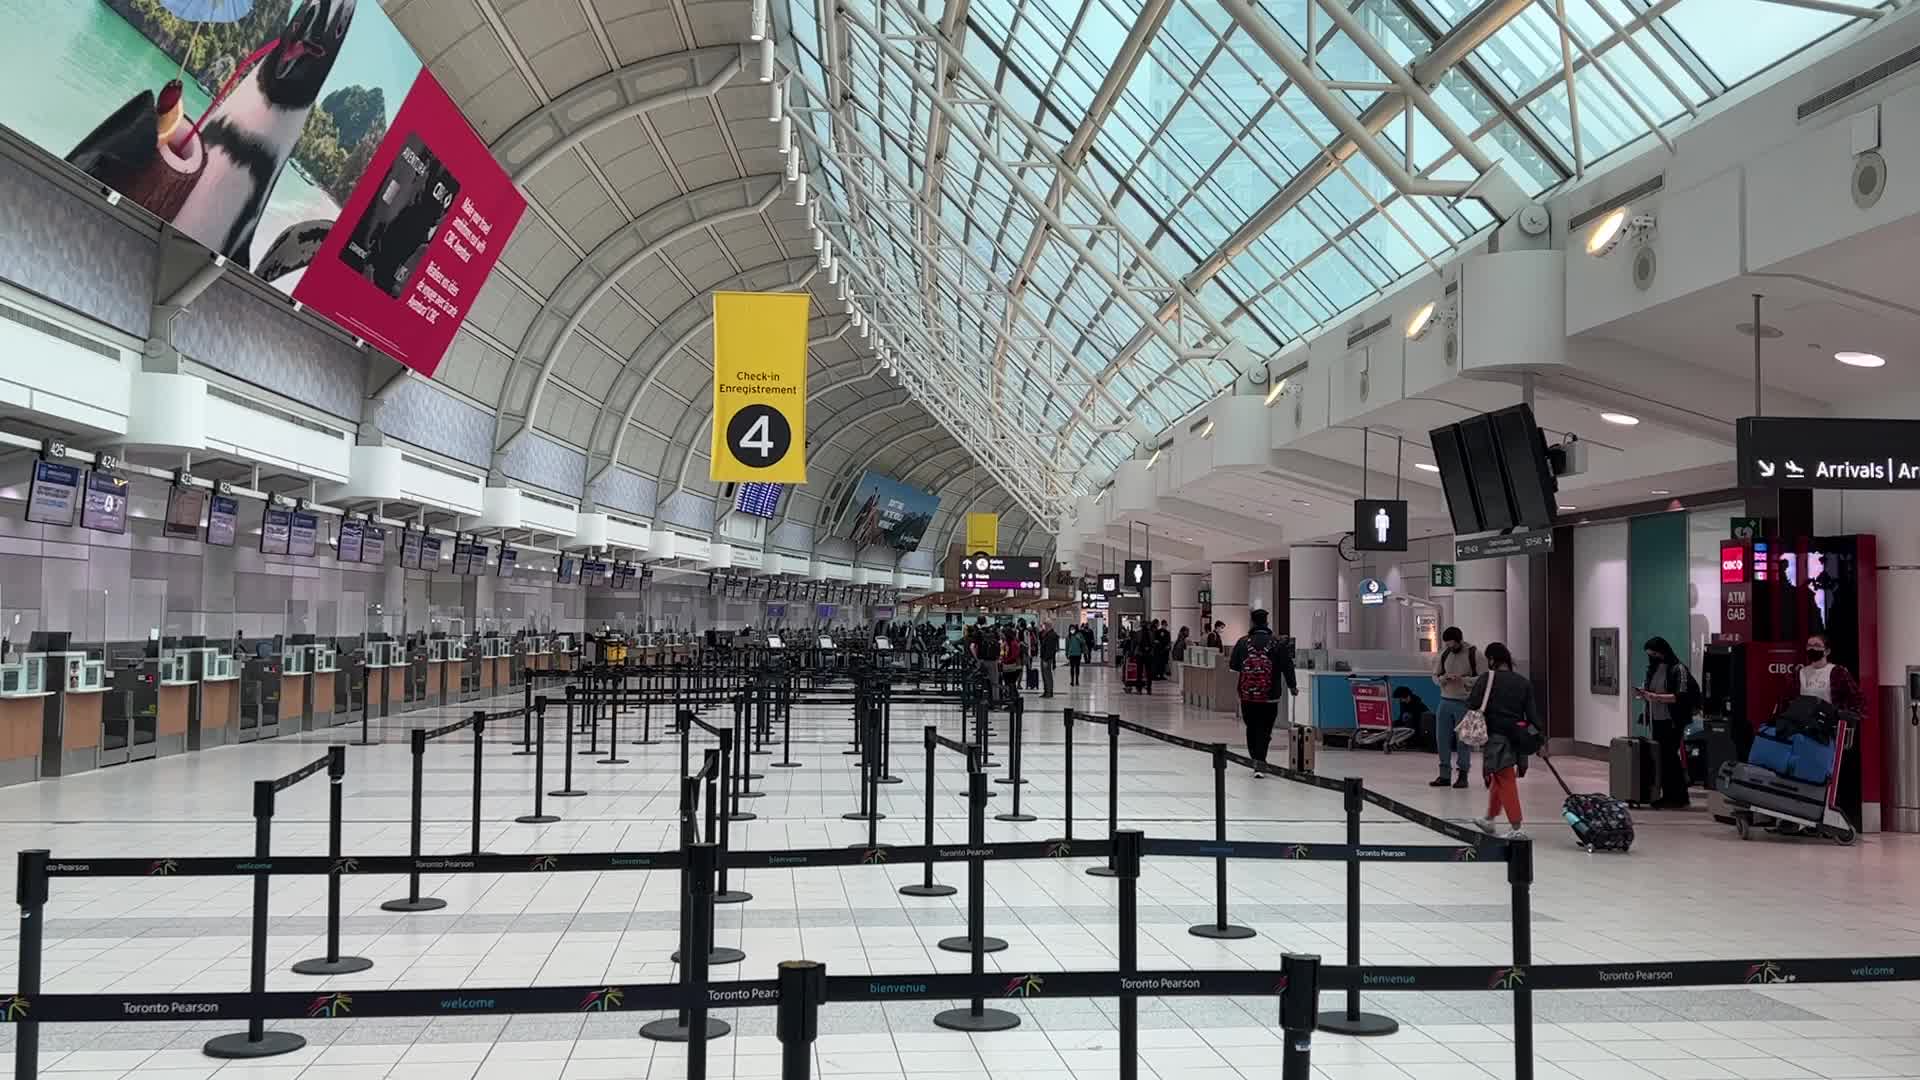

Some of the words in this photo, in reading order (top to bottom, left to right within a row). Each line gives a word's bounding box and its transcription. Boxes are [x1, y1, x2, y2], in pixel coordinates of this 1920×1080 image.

[737, 371, 780, 381] Check-in
[719, 384, 797, 395] Enregistrement
[739, 415, 774, 457] 4
[50, 442, 65, 458] 425
[101, 455, 116, 469] 424
[1816, 461, 1884, 479] Arrivals
[1722, 560, 1737, 570] CIBC
[1727, 591, 1746, 604] ATM
[1727, 607, 1746, 620] GAB
[1768, 663, 1794, 674] CIBC
[940, 848, 966, 857] Toronto
[966, 848, 994, 856] Pearson
[1355, 849, 1380, 857] Toronto
[1381, 849, 1407, 857] Pearson
[58, 863, 89, 871] Pearson
[415, 860, 443, 868] Toronto
[444, 859, 474, 868] Pearson
[1600, 970, 1635, 981] Toronto
[1636, 970, 1673, 981] Pearson
[1850, 966, 1895, 976] welcome
[1120, 977, 1159, 989] Toronto
[1160, 977, 1200, 989] Pearson
[1363, 973, 1416, 984] bienvenue
[870, 983, 926, 993] bienvenue
[708, 989, 750, 1001] Toronto
[123, 1002, 169, 1013] Toronto
[171, 1001, 219, 1013] Pearson
[440, 996, 496, 1009] welcome
